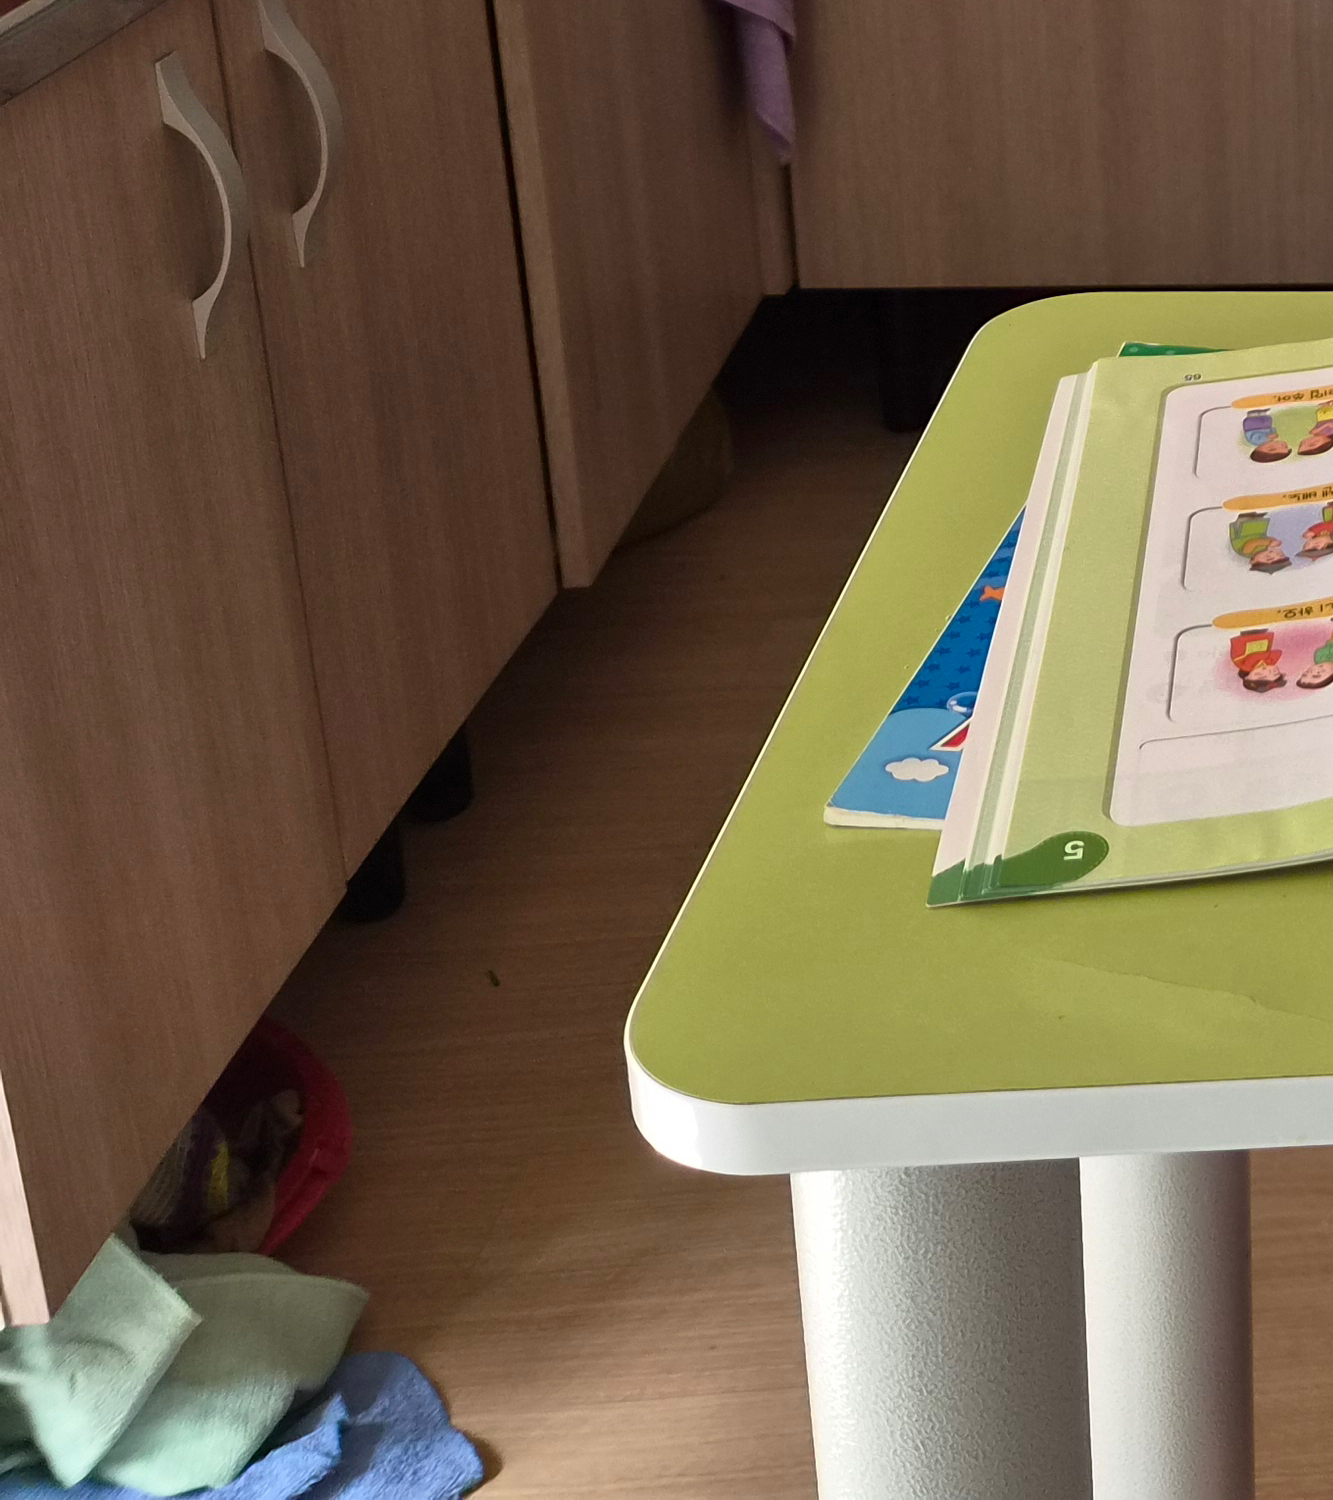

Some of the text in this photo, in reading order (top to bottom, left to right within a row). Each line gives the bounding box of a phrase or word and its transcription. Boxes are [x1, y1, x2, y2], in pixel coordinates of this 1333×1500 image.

[1281, 489, 1319, 502] 베노.
[1276, 604, 1314, 621] 하오.
[1063, 841, 1085, 860] 5
